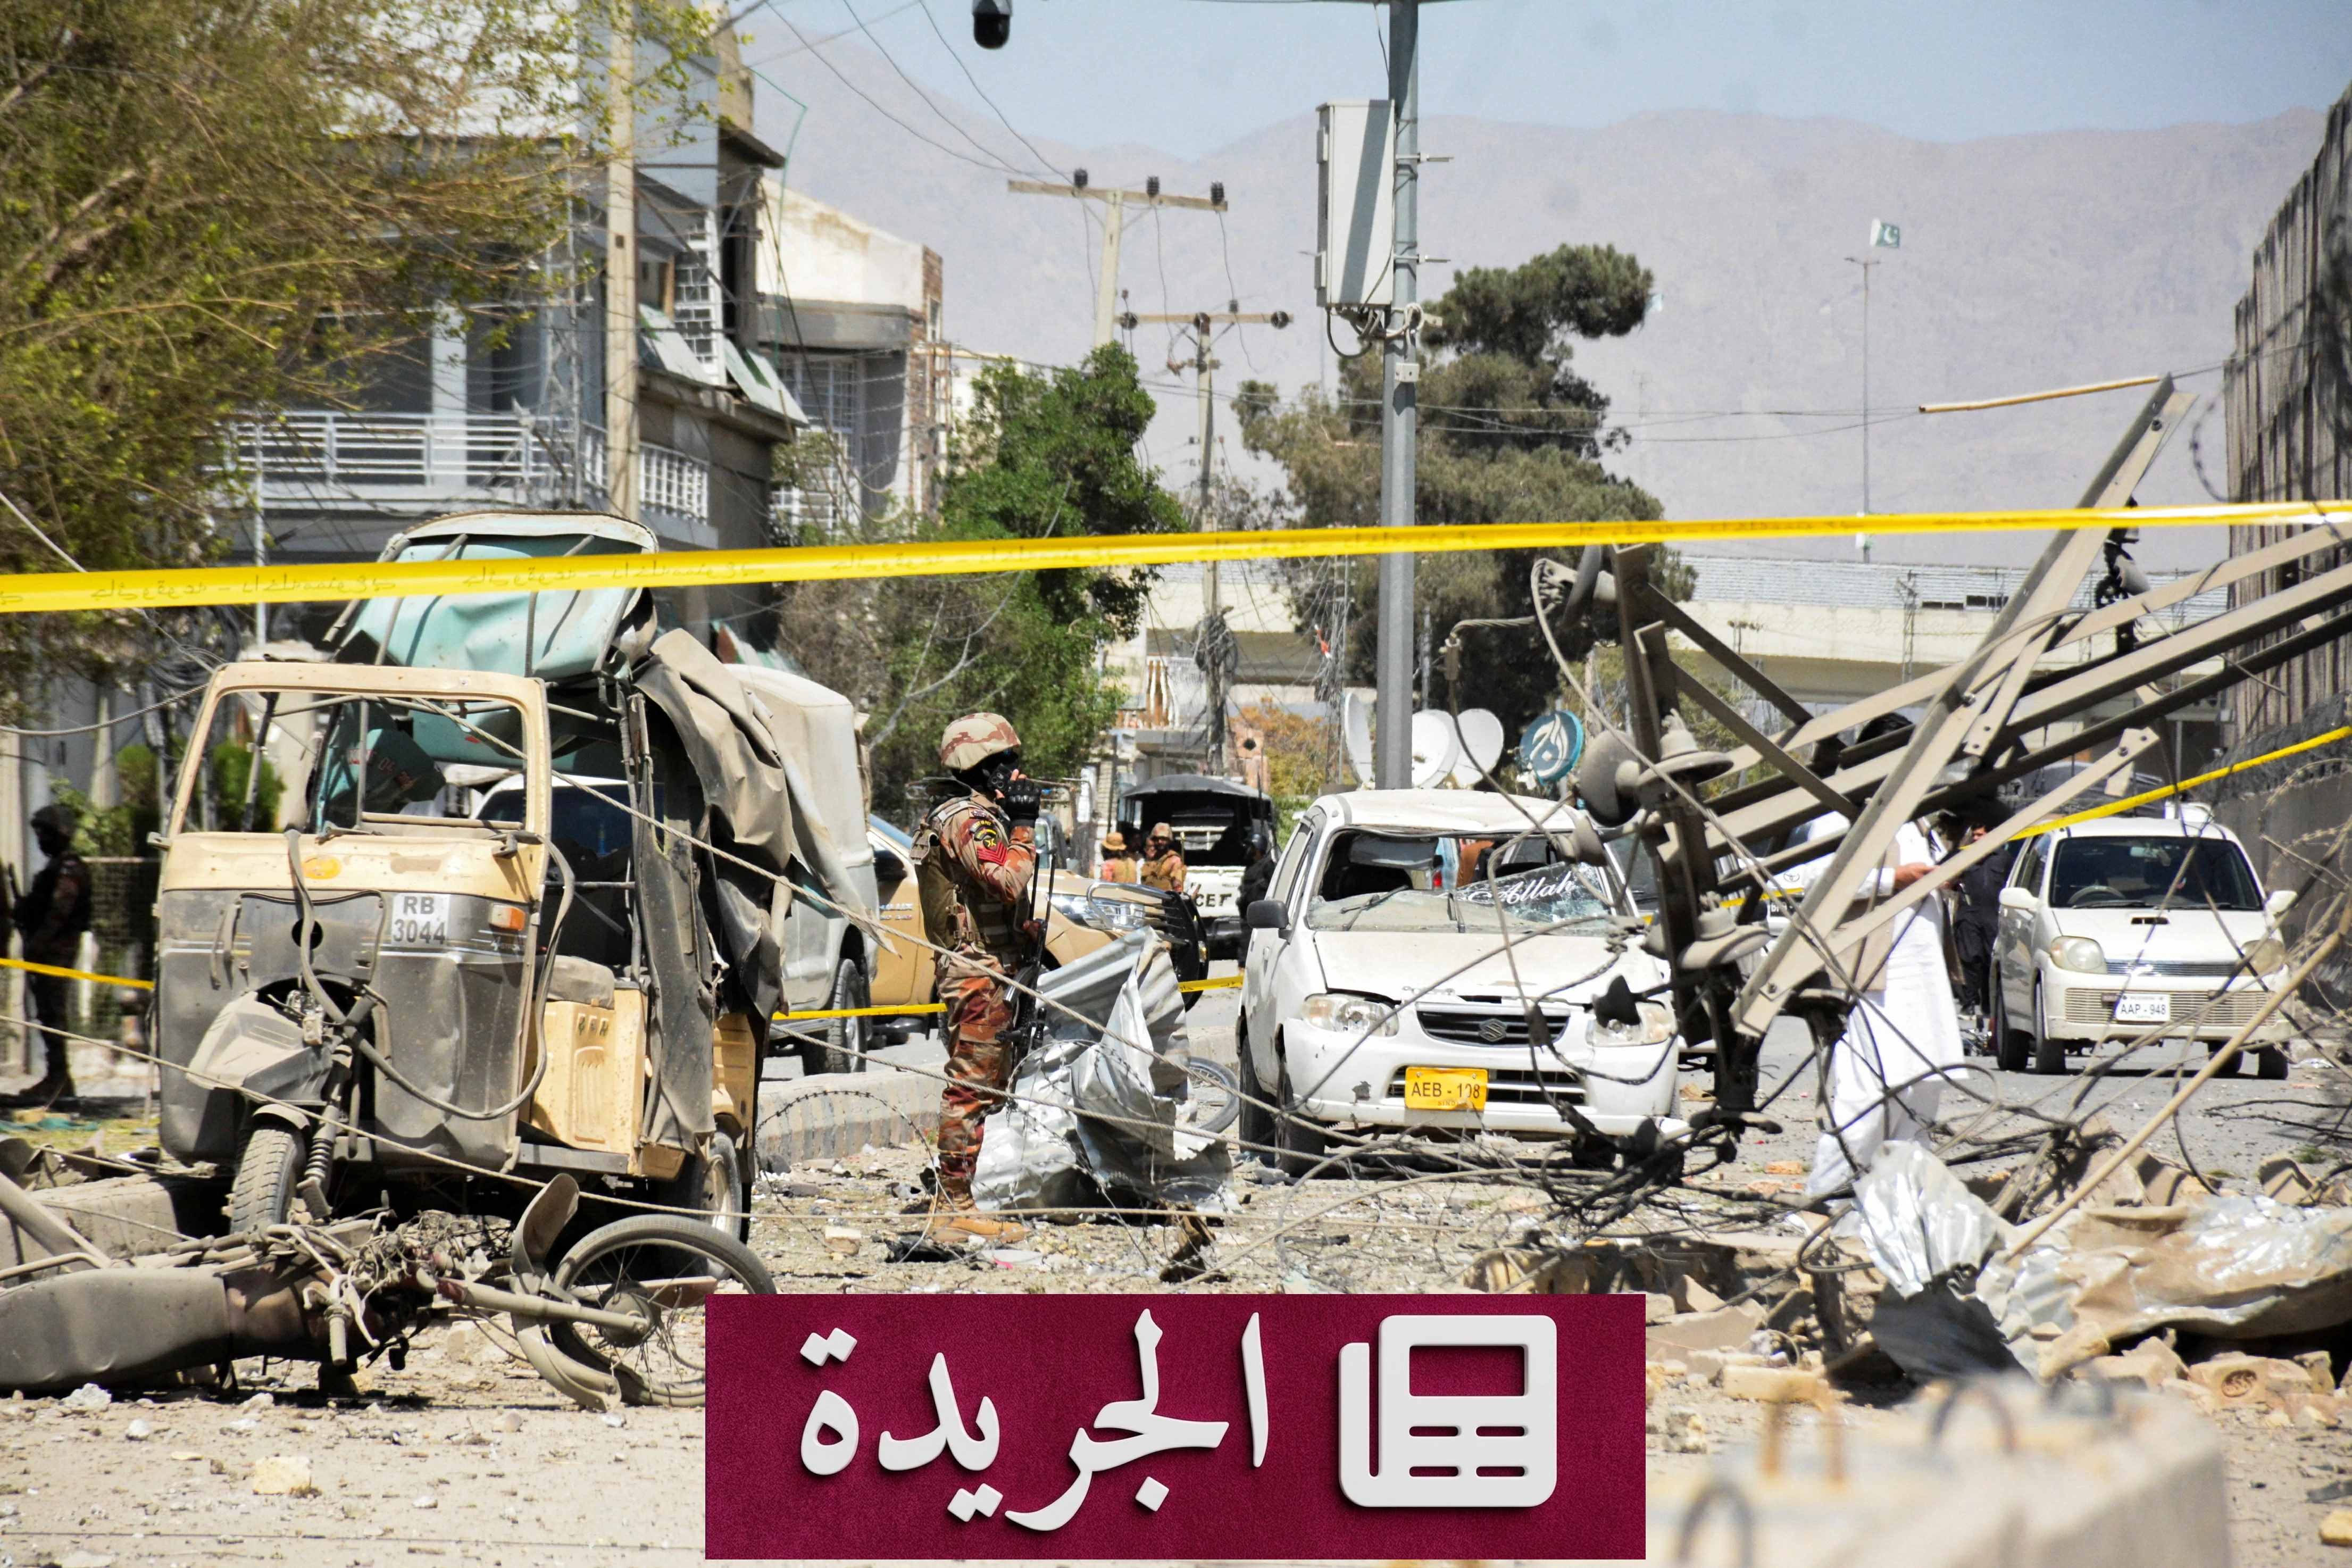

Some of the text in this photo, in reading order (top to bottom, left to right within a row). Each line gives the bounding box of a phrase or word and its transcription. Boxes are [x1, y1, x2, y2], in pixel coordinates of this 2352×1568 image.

[403, 896, 435, 914] RB
[393, 919, 446, 945] 3044
[2121, 1004, 2141, 1014] AAP
[2149, 1004, 2166, 1015] 948
[1411, 1082, 1442, 1097] AEB
[1457, 1083, 1480, 1099] 108
